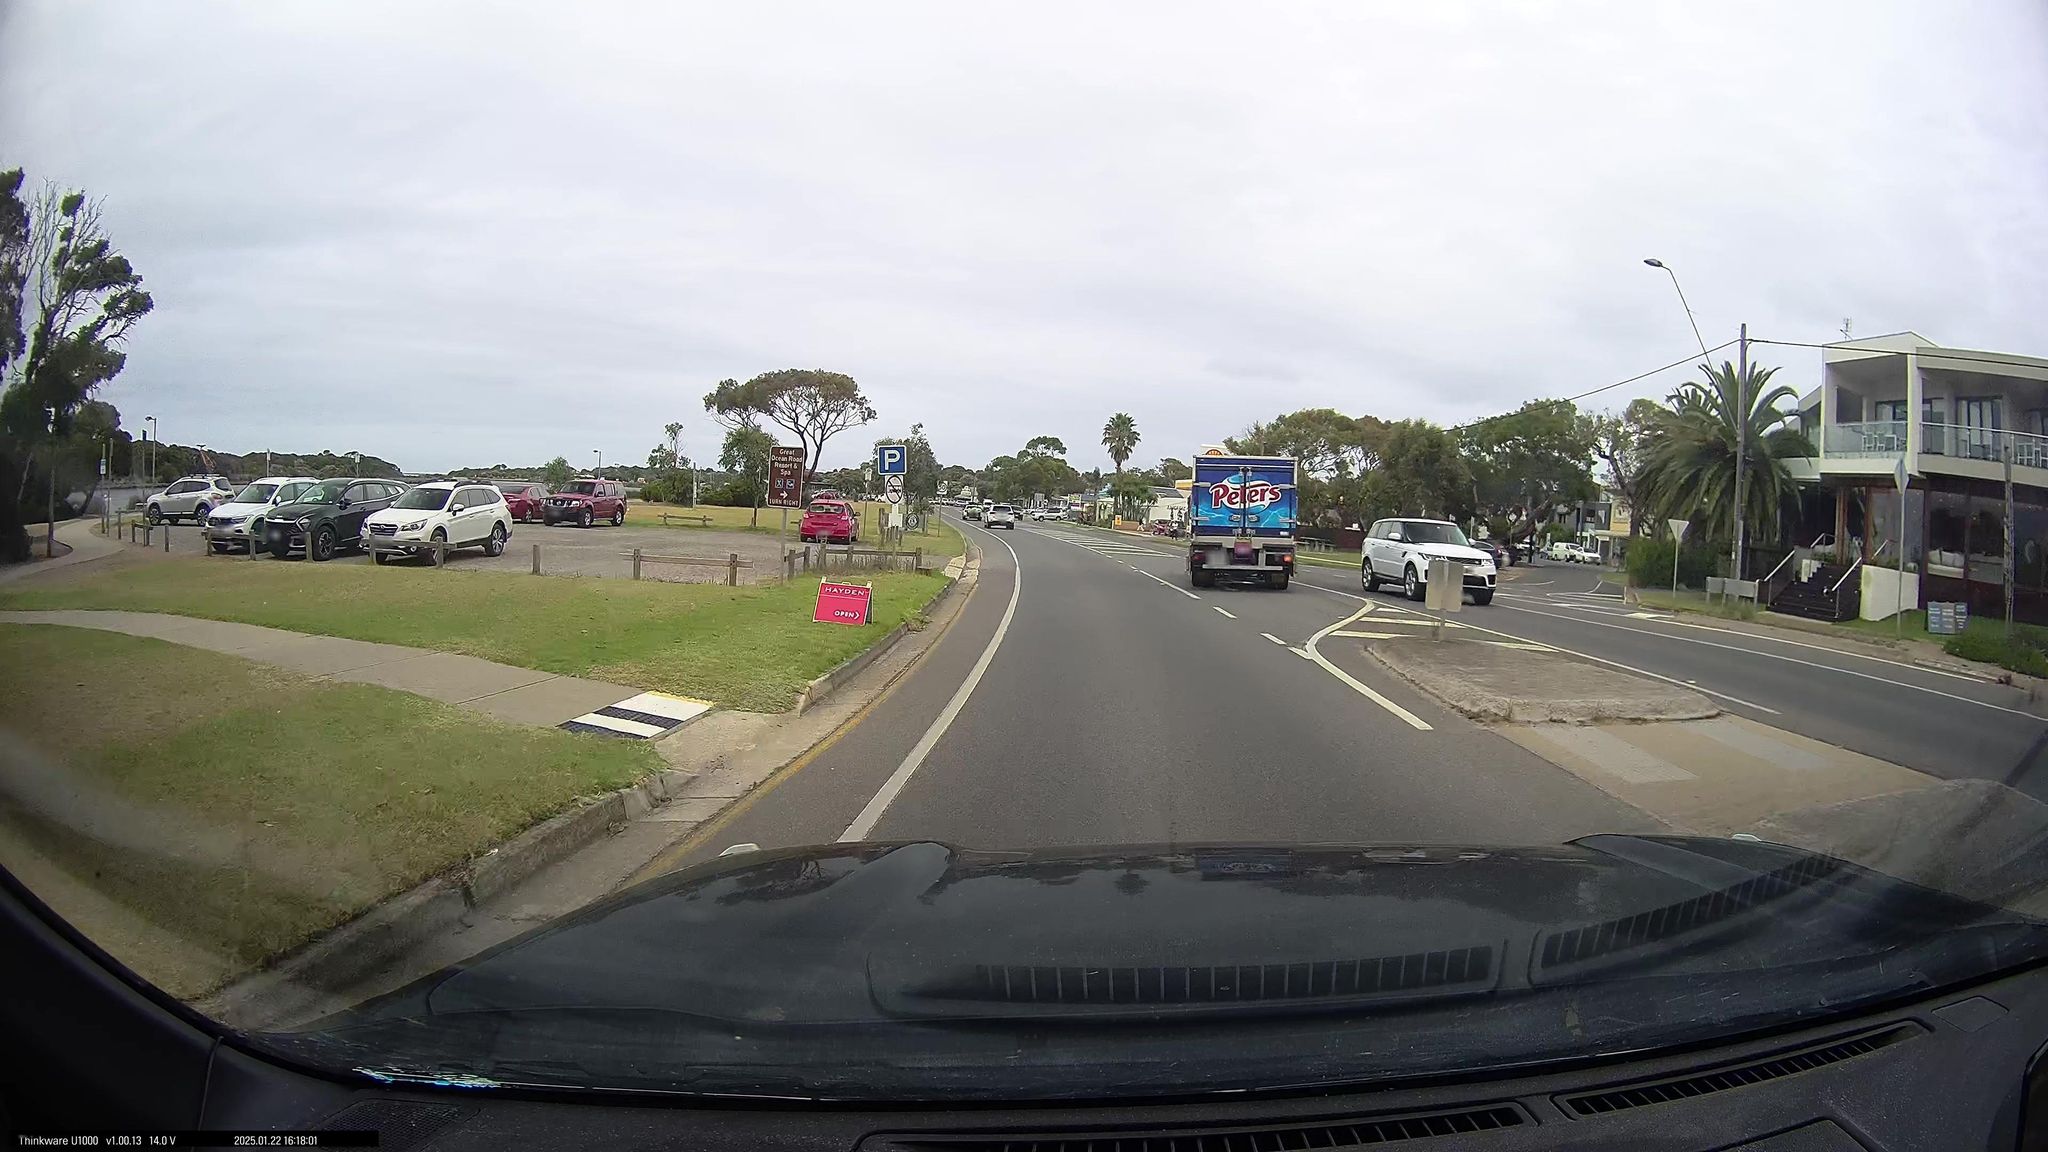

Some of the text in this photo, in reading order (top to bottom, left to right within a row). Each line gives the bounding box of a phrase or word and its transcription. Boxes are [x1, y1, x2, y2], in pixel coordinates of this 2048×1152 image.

[884, 449, 901, 471] P
[1209, 482, 1281, 507] Peters
[825, 587, 865, 596] HAYDEN
[834, 610, 855, 618] OPEN
